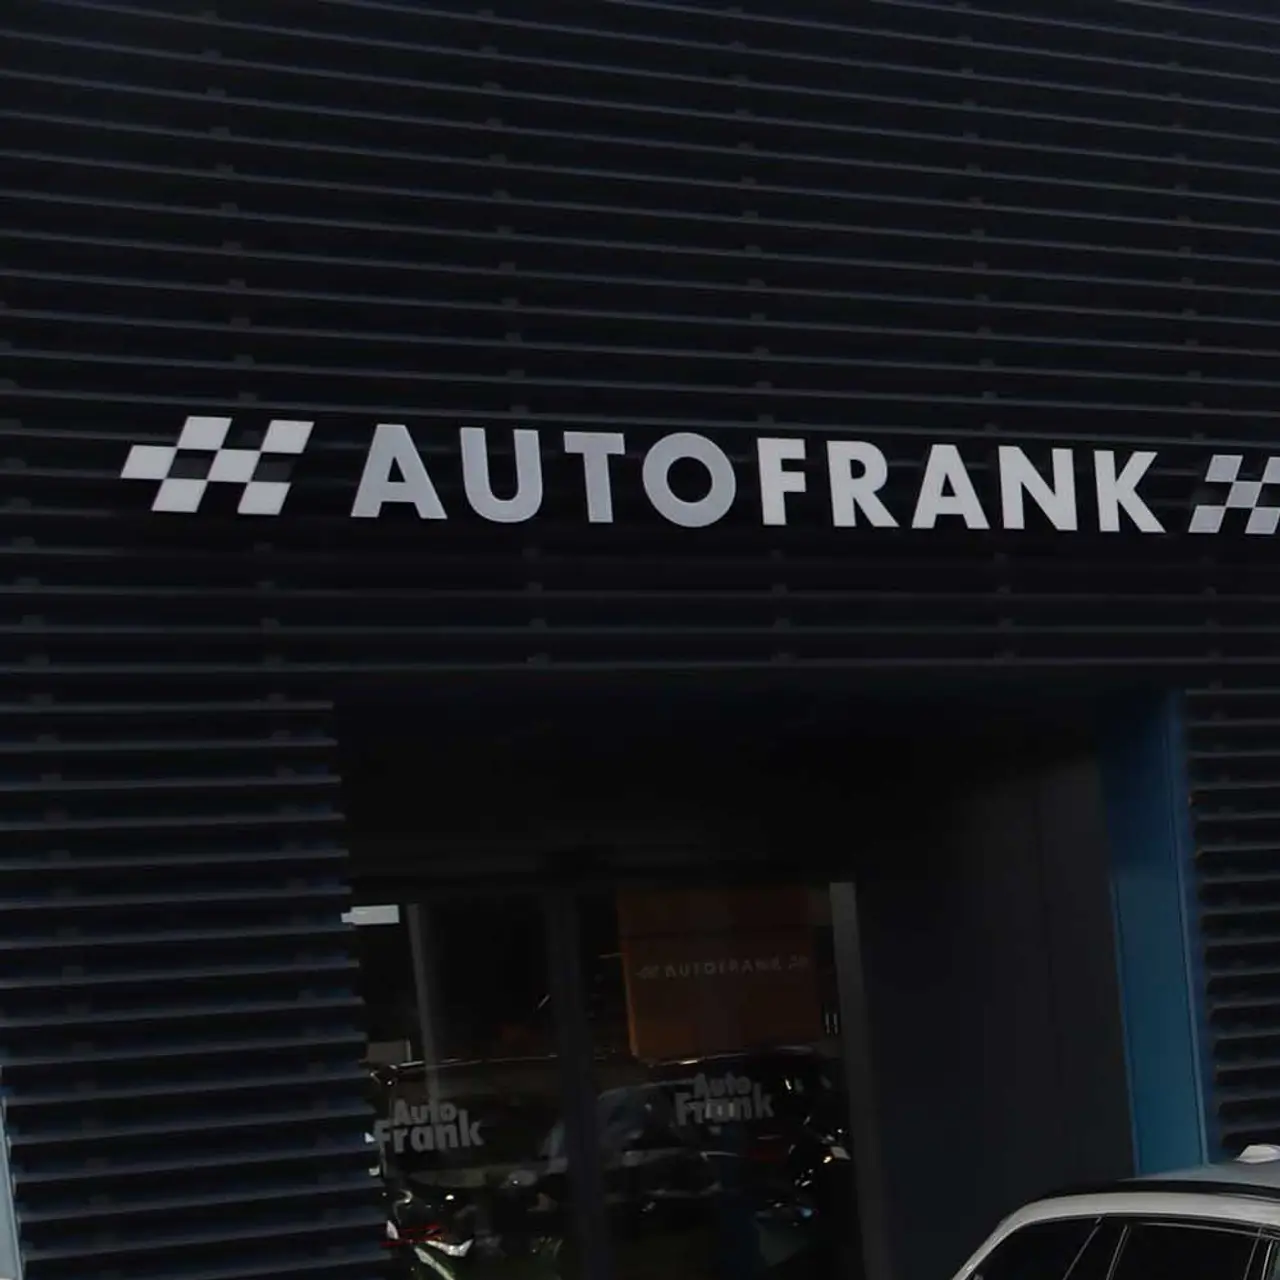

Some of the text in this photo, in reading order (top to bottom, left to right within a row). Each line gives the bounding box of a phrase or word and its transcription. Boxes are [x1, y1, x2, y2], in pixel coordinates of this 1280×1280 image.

[351, 423, 1166, 533] AUTOFRANK
[674, 1082, 775, 1126] Frank
[692, 1071, 752, 1098] Auto
[373, 1109, 485, 1154] Frank
[392, 1098, 458, 1126] Auto
